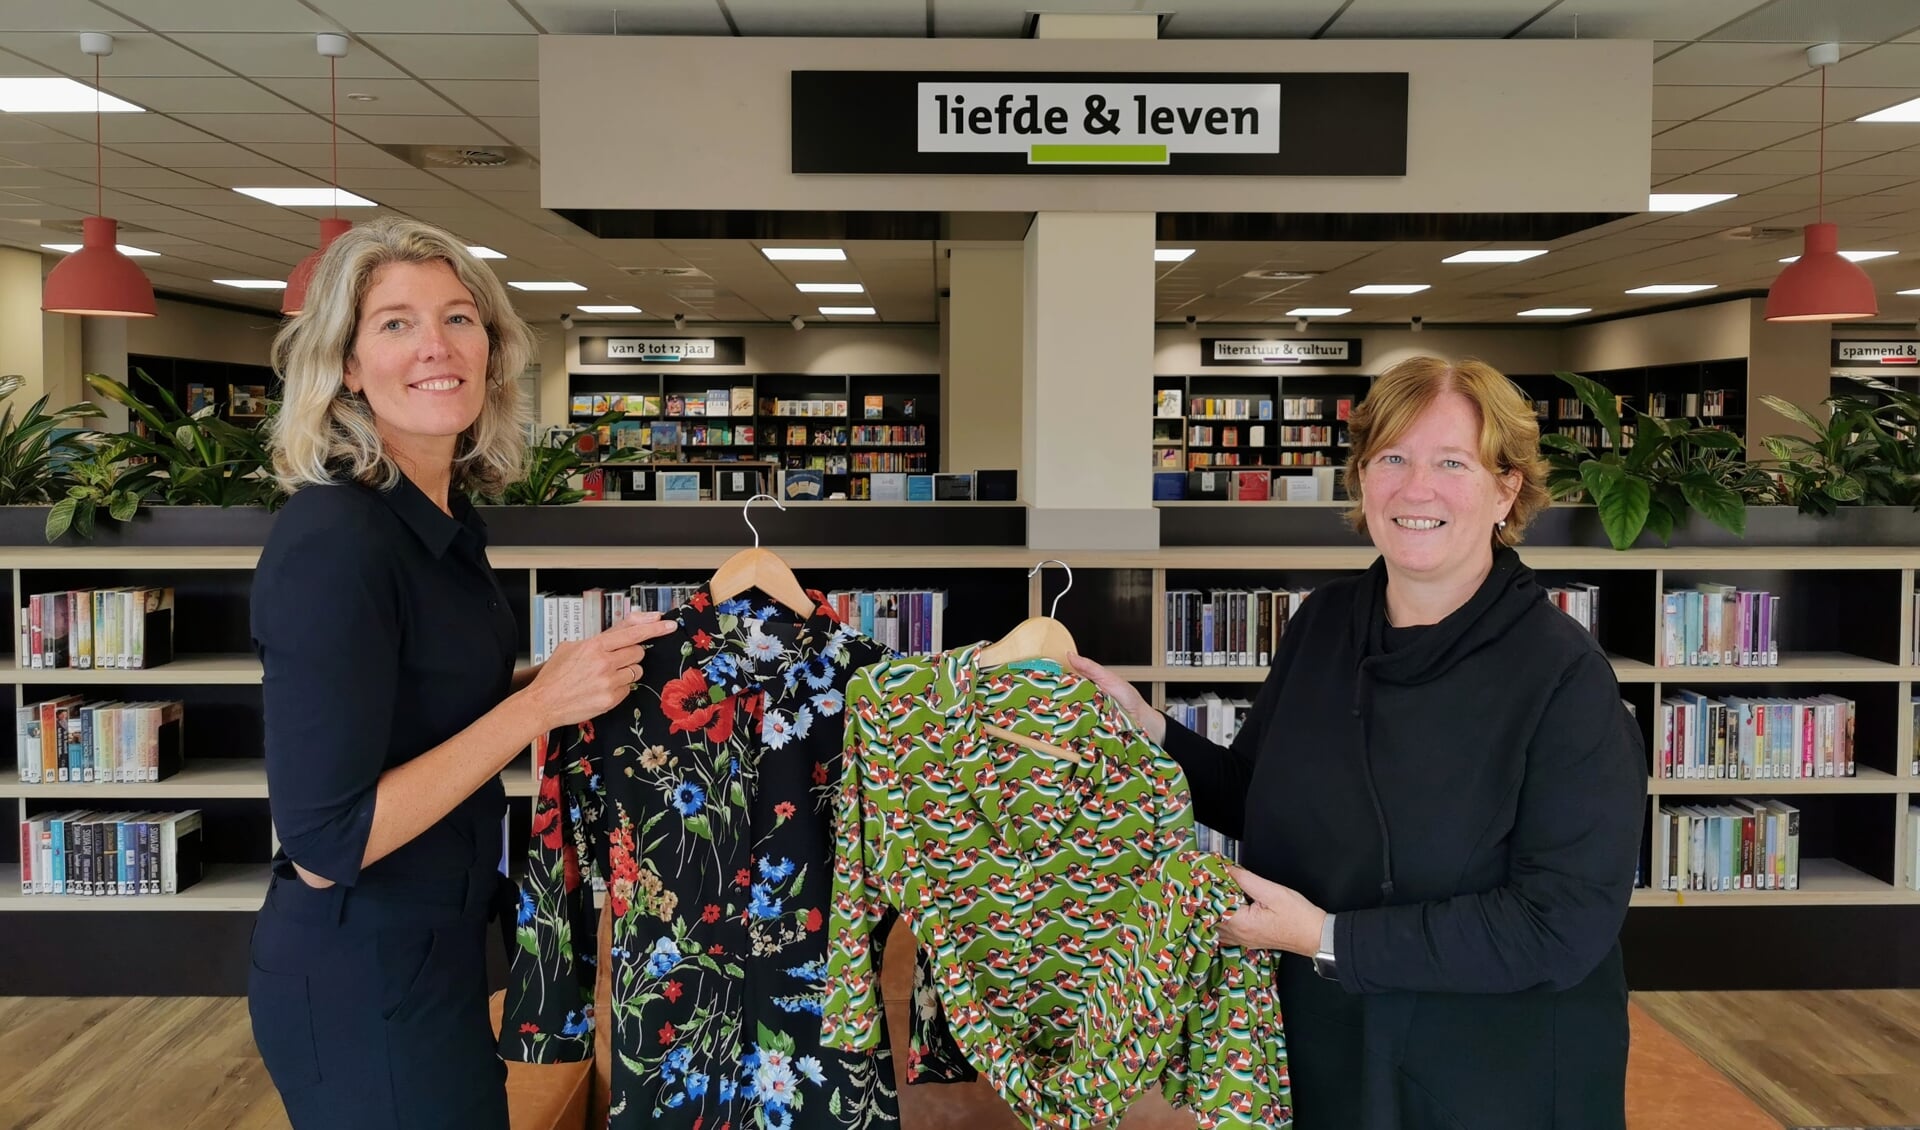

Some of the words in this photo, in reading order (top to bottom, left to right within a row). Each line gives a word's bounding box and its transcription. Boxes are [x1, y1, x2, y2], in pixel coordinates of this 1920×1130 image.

[934, 94, 1069, 135] liefde
[1083, 94, 1121, 136] &
[1133, 95, 1260, 135] leven
[611, 344, 635, 354] van
[638, 343, 646, 354] 8
[648, 343, 667, 354] tot
[669, 345, 681, 354] 12
[683, 343, 711, 358] jaar
[1218, 343, 1279, 356] literatuur
[1283, 344, 1294, 355] &
[1296, 343, 1344, 356] cultuur
[1843, 345, 1903, 358] spannend
[1907, 345, 1917, 356] &
